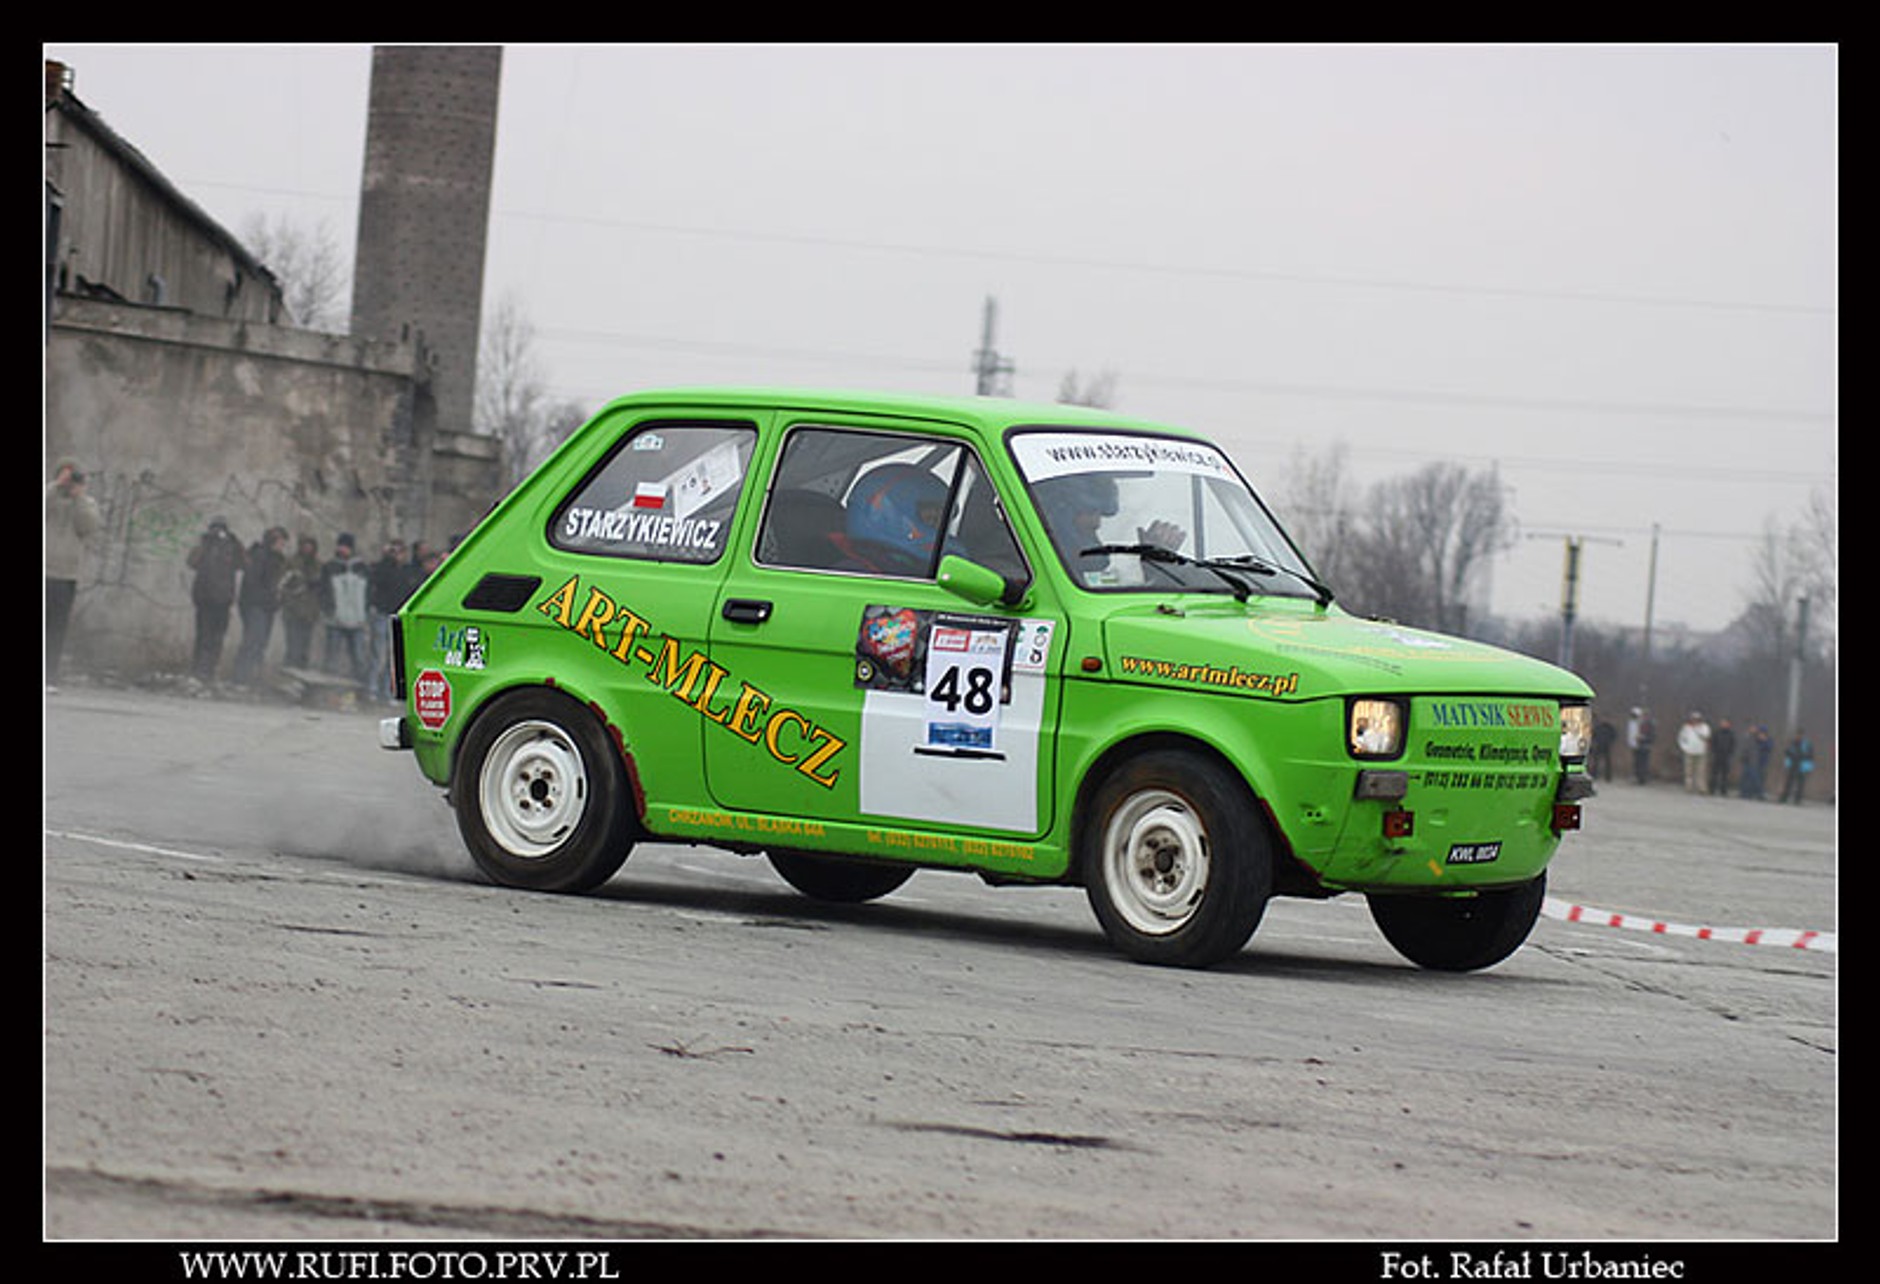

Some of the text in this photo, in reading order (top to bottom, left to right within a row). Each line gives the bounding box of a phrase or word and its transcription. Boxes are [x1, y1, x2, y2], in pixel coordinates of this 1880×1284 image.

[565, 508, 720, 549] STARZYKIEWICZ
[418, 680, 446, 698] STOP
[537, 574, 847, 790] ART-MLECZ
[930, 665, 994, 715] 48
[1120, 655, 1299, 697] www.artmlecz.pl
[1431, 702, 1505, 727] MATYSIK
